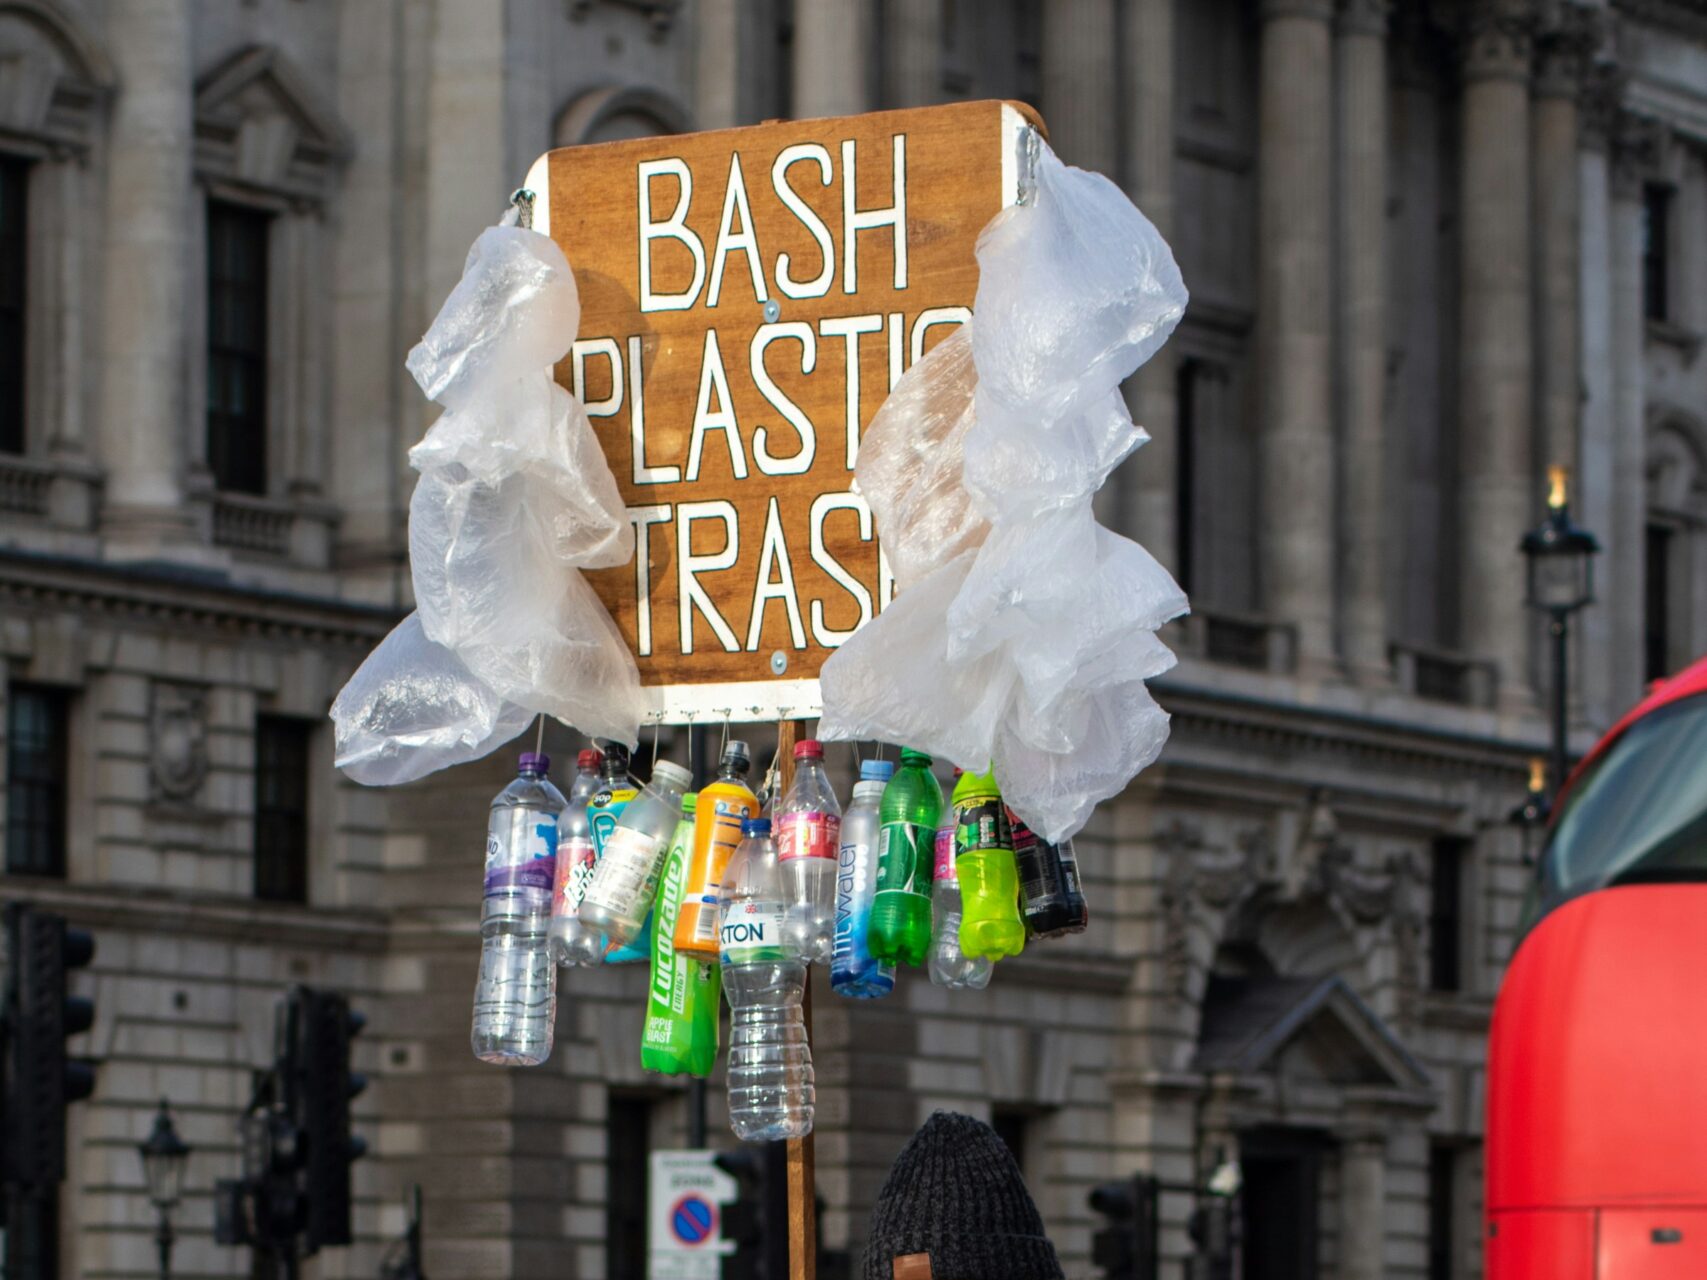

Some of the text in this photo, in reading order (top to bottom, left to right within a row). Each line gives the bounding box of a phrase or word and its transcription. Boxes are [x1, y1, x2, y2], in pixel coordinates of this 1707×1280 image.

[636, 132, 908, 313] BASH
[563, 865, 598, 911] Pepp
[569, 858, 590, 881] Dr
[673, 971, 686, 1012] ENERGY
[649, 1016, 674, 1032] APPLE
